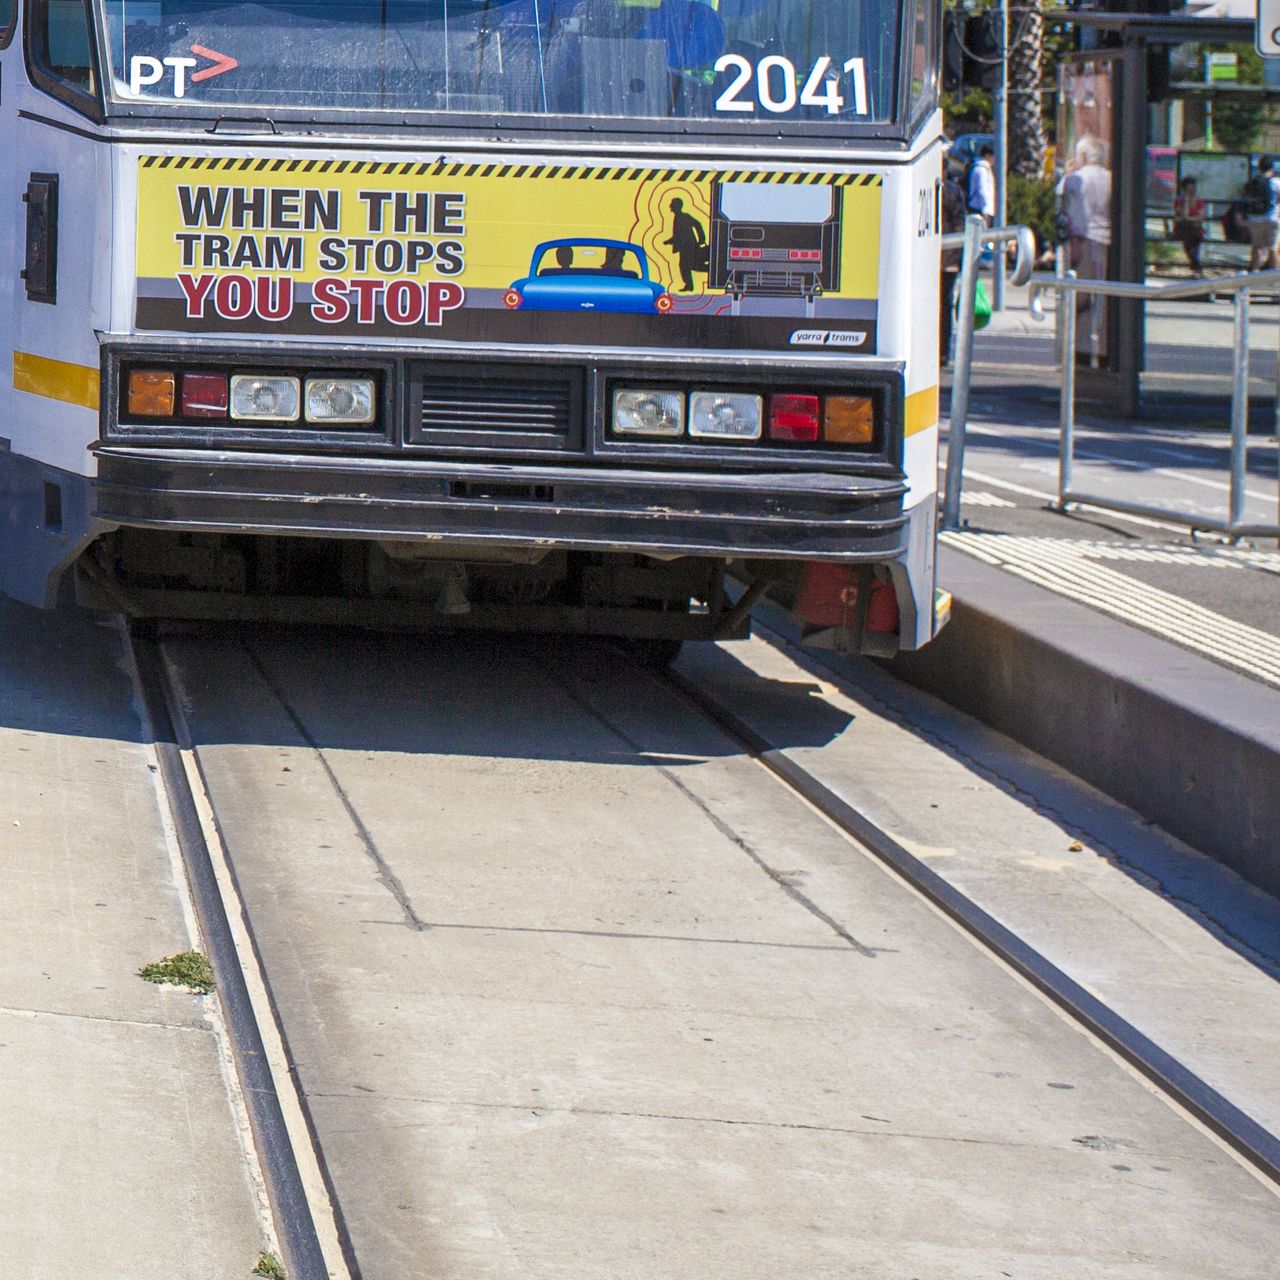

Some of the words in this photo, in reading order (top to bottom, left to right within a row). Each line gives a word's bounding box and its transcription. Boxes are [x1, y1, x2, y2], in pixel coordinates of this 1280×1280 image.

[713, 54, 868, 115] 2041
[176, 185, 340, 231] WHEN
[358, 189, 466, 236] THE
[175, 233, 304, 271] TRAM
[318, 237, 465, 275] STOPS
[176, 273, 294, 321] YOU
[310, 276, 466, 326] STOP
[796, 333, 822, 342] yarra
[831, 333, 860, 342] trams
